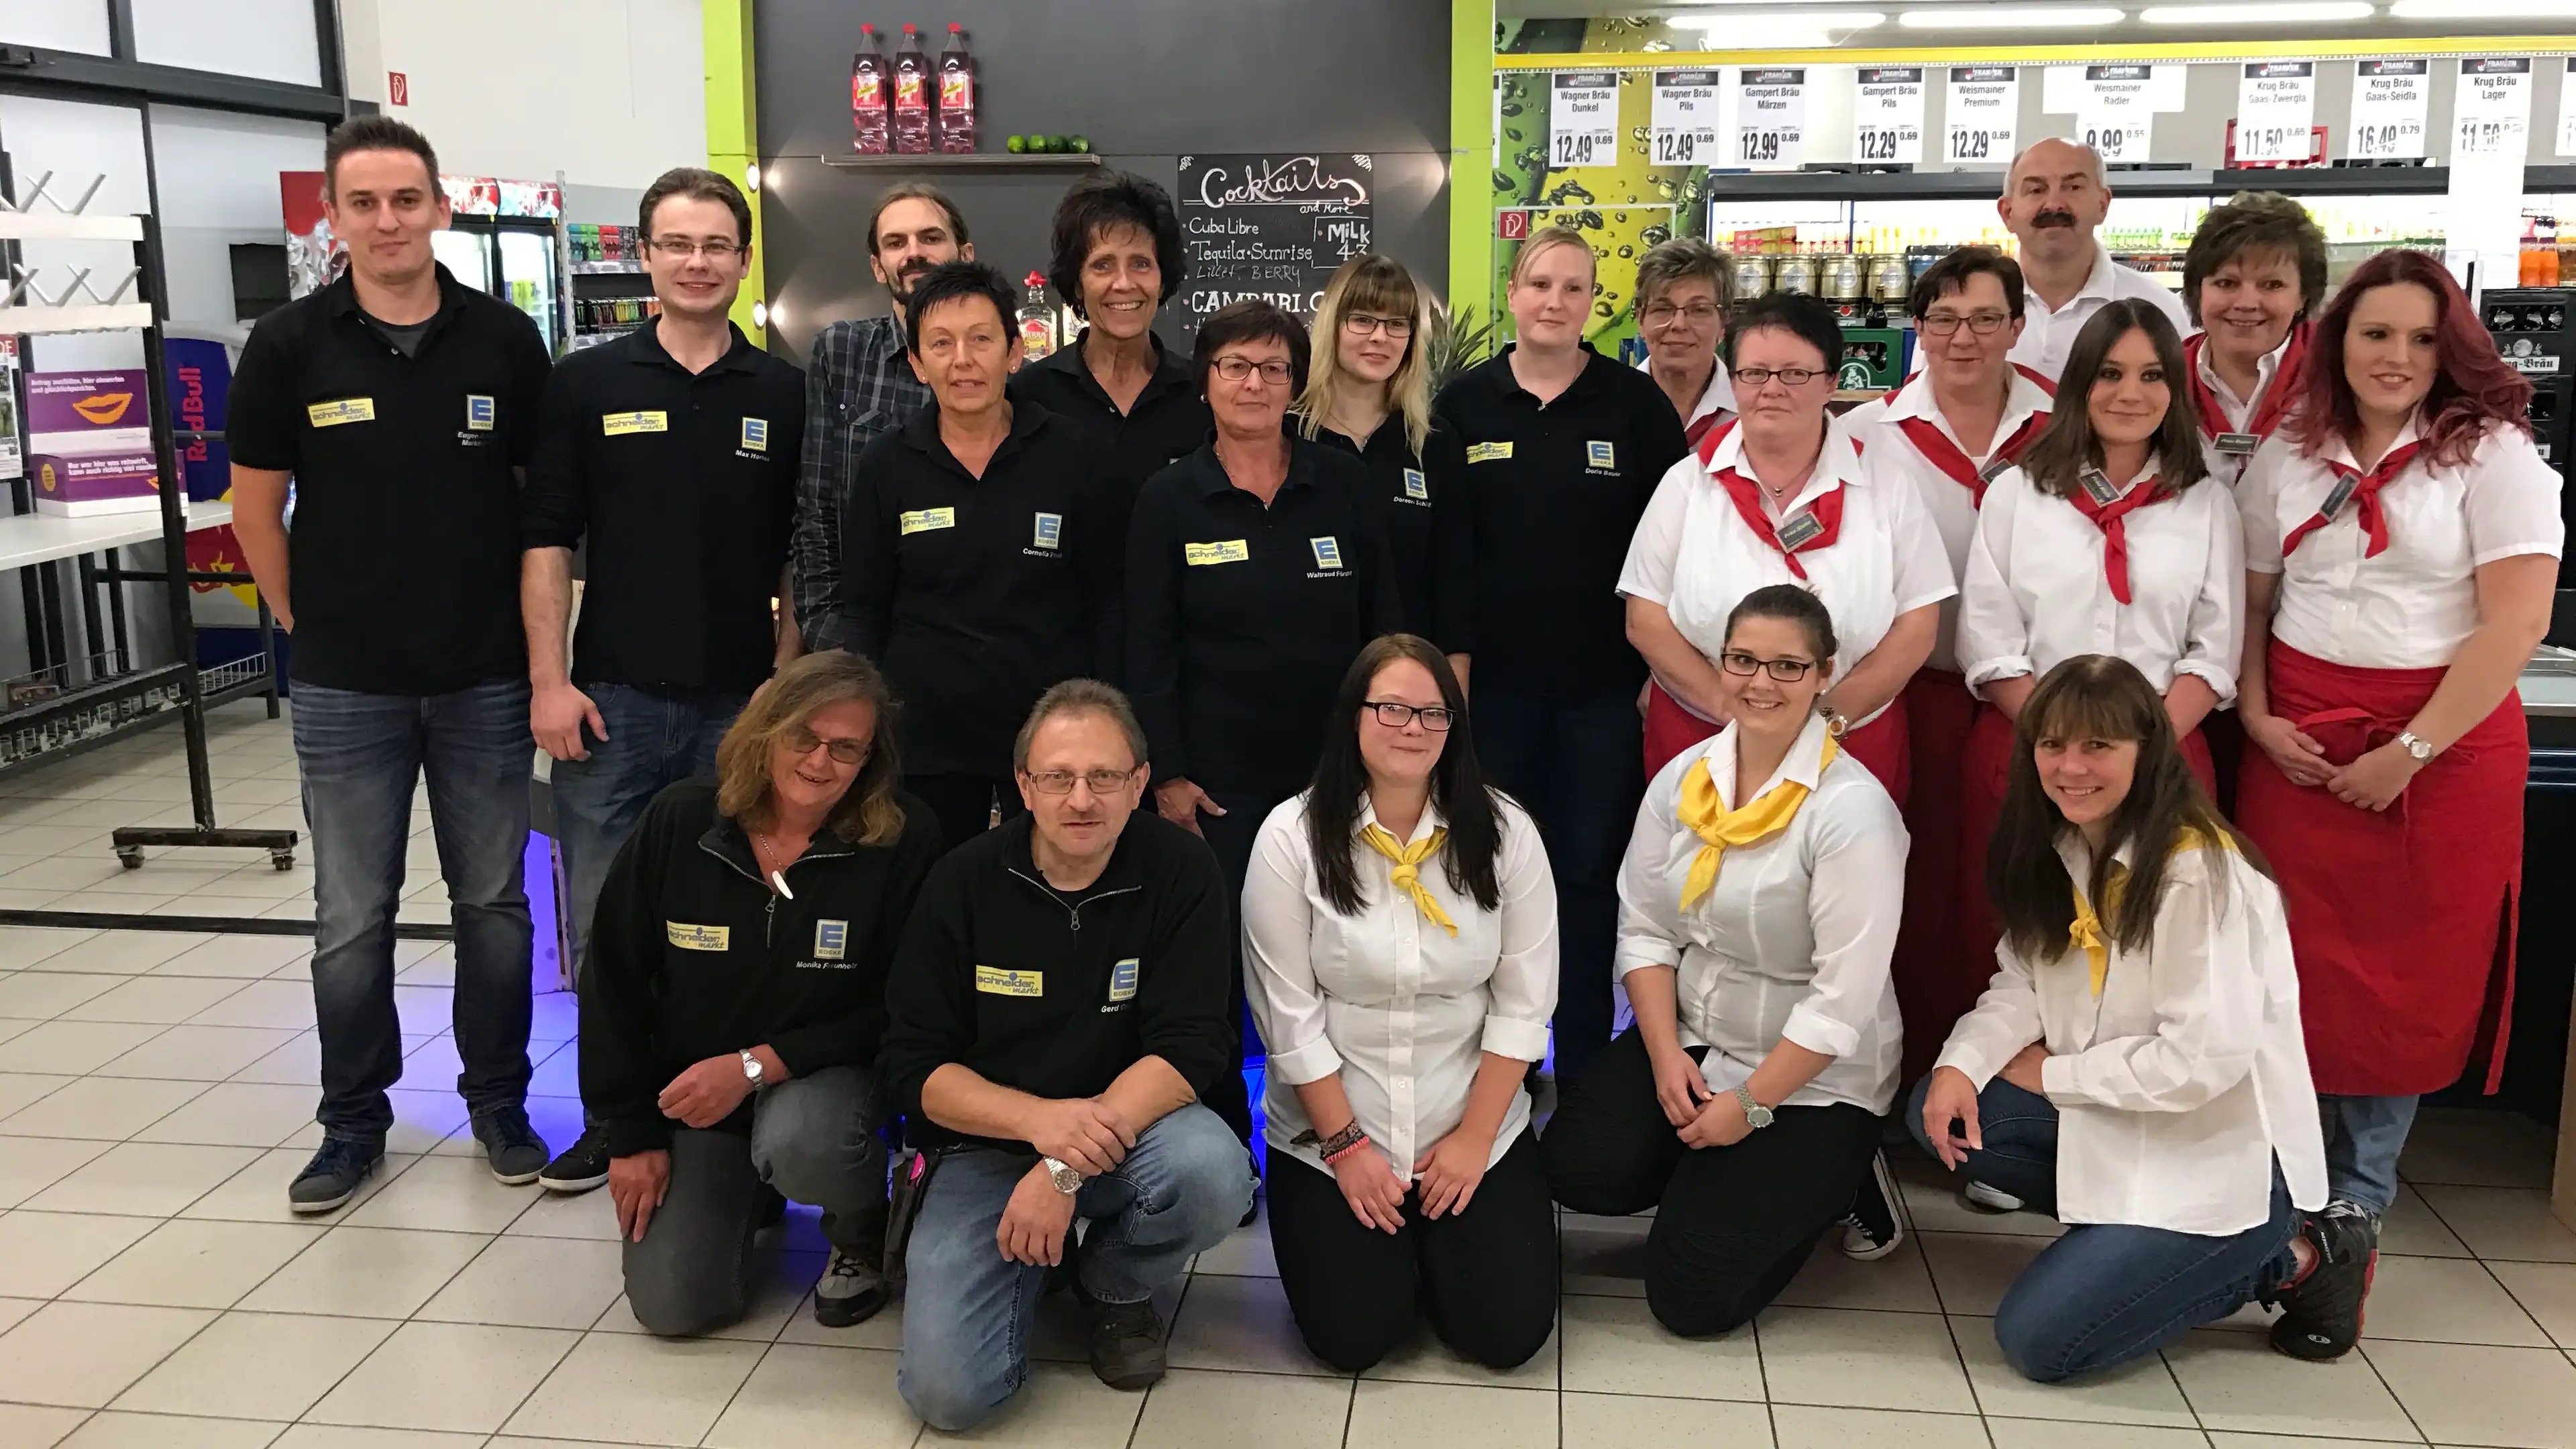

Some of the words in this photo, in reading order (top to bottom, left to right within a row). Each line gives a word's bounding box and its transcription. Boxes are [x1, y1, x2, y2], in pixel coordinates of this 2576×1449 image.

[2257, 80, 2276, 91] Krug
[2279, 80, 2299, 89] Bräu
[2371, 78, 2390, 89] Krug
[2394, 78, 2413, 87] Bräu
[2474, 76, 2494, 88] Krug
[2496, 76, 2516, 86] Bräu
[1746, 87, 1779, 98] Gampert
[1780, 87, 1799, 96] Bräu
[1863, 86, 1896, 97] Gampert
[1898, 85, 1917, 95] Bräu
[1959, 85, 2006, 95] Weismainer
[2094, 83, 2141, 93] Weismainer
[1561, 91, 1590, 101] Wagner
[1592, 90, 1610, 99] Bräu
[1662, 89, 1691, 99] Wagner
[1694, 88, 1712, 98] Bräu
[2366, 91, 2416, 101] Gaas-Seidla
[2482, 90, 2506, 100] Lager
[1758, 99, 1786, 109] Märzen
[1882, 99, 1896, 108] Pils
[1964, 98, 2000, 107] Premium
[2104, 96, 2130, 105] Radler
[1572, 103, 1599, 112] Dunkel
[1679, 101, 1693, 111] Pils
[2401, 125, 2420, 134] 0.79
[1595, 134, 1612, 144] 0.69
[1697, 133, 1714, 143] 0.69
[1781, 133, 1799, 142] 0.69
[1899, 131, 1917, 140] 0.69
[1992, 131, 2010, 140] 0.69
[1658, 133, 1693, 161] 12.49
[1742, 132, 1778, 160] 12.99
[1860, 131, 1896, 158] 12.29
[1952, 130, 1988, 158] 12.29
[2086, 129, 2123, 157] 999
[1557, 135, 1592, 162] 12.49
[1201, 156, 1366, 208] Cocktails
[1299, 201, 1320, 214] and
[1189, 217, 1225, 234] Cuba
[1227, 218, 1259, 234] Libre
[178, 366, 206, 413] Bull
[735, 449, 749, 458] Max
[1023, 547, 1049, 558] Cornelia
[1189, 547, 1239, 559] schneider
[1307, 571, 1335, 579] Waltraud
[796, 961, 822, 969] Monika
[977, 975, 1035, 988] schneider
[1101, 1005, 1119, 1013] Gerd
